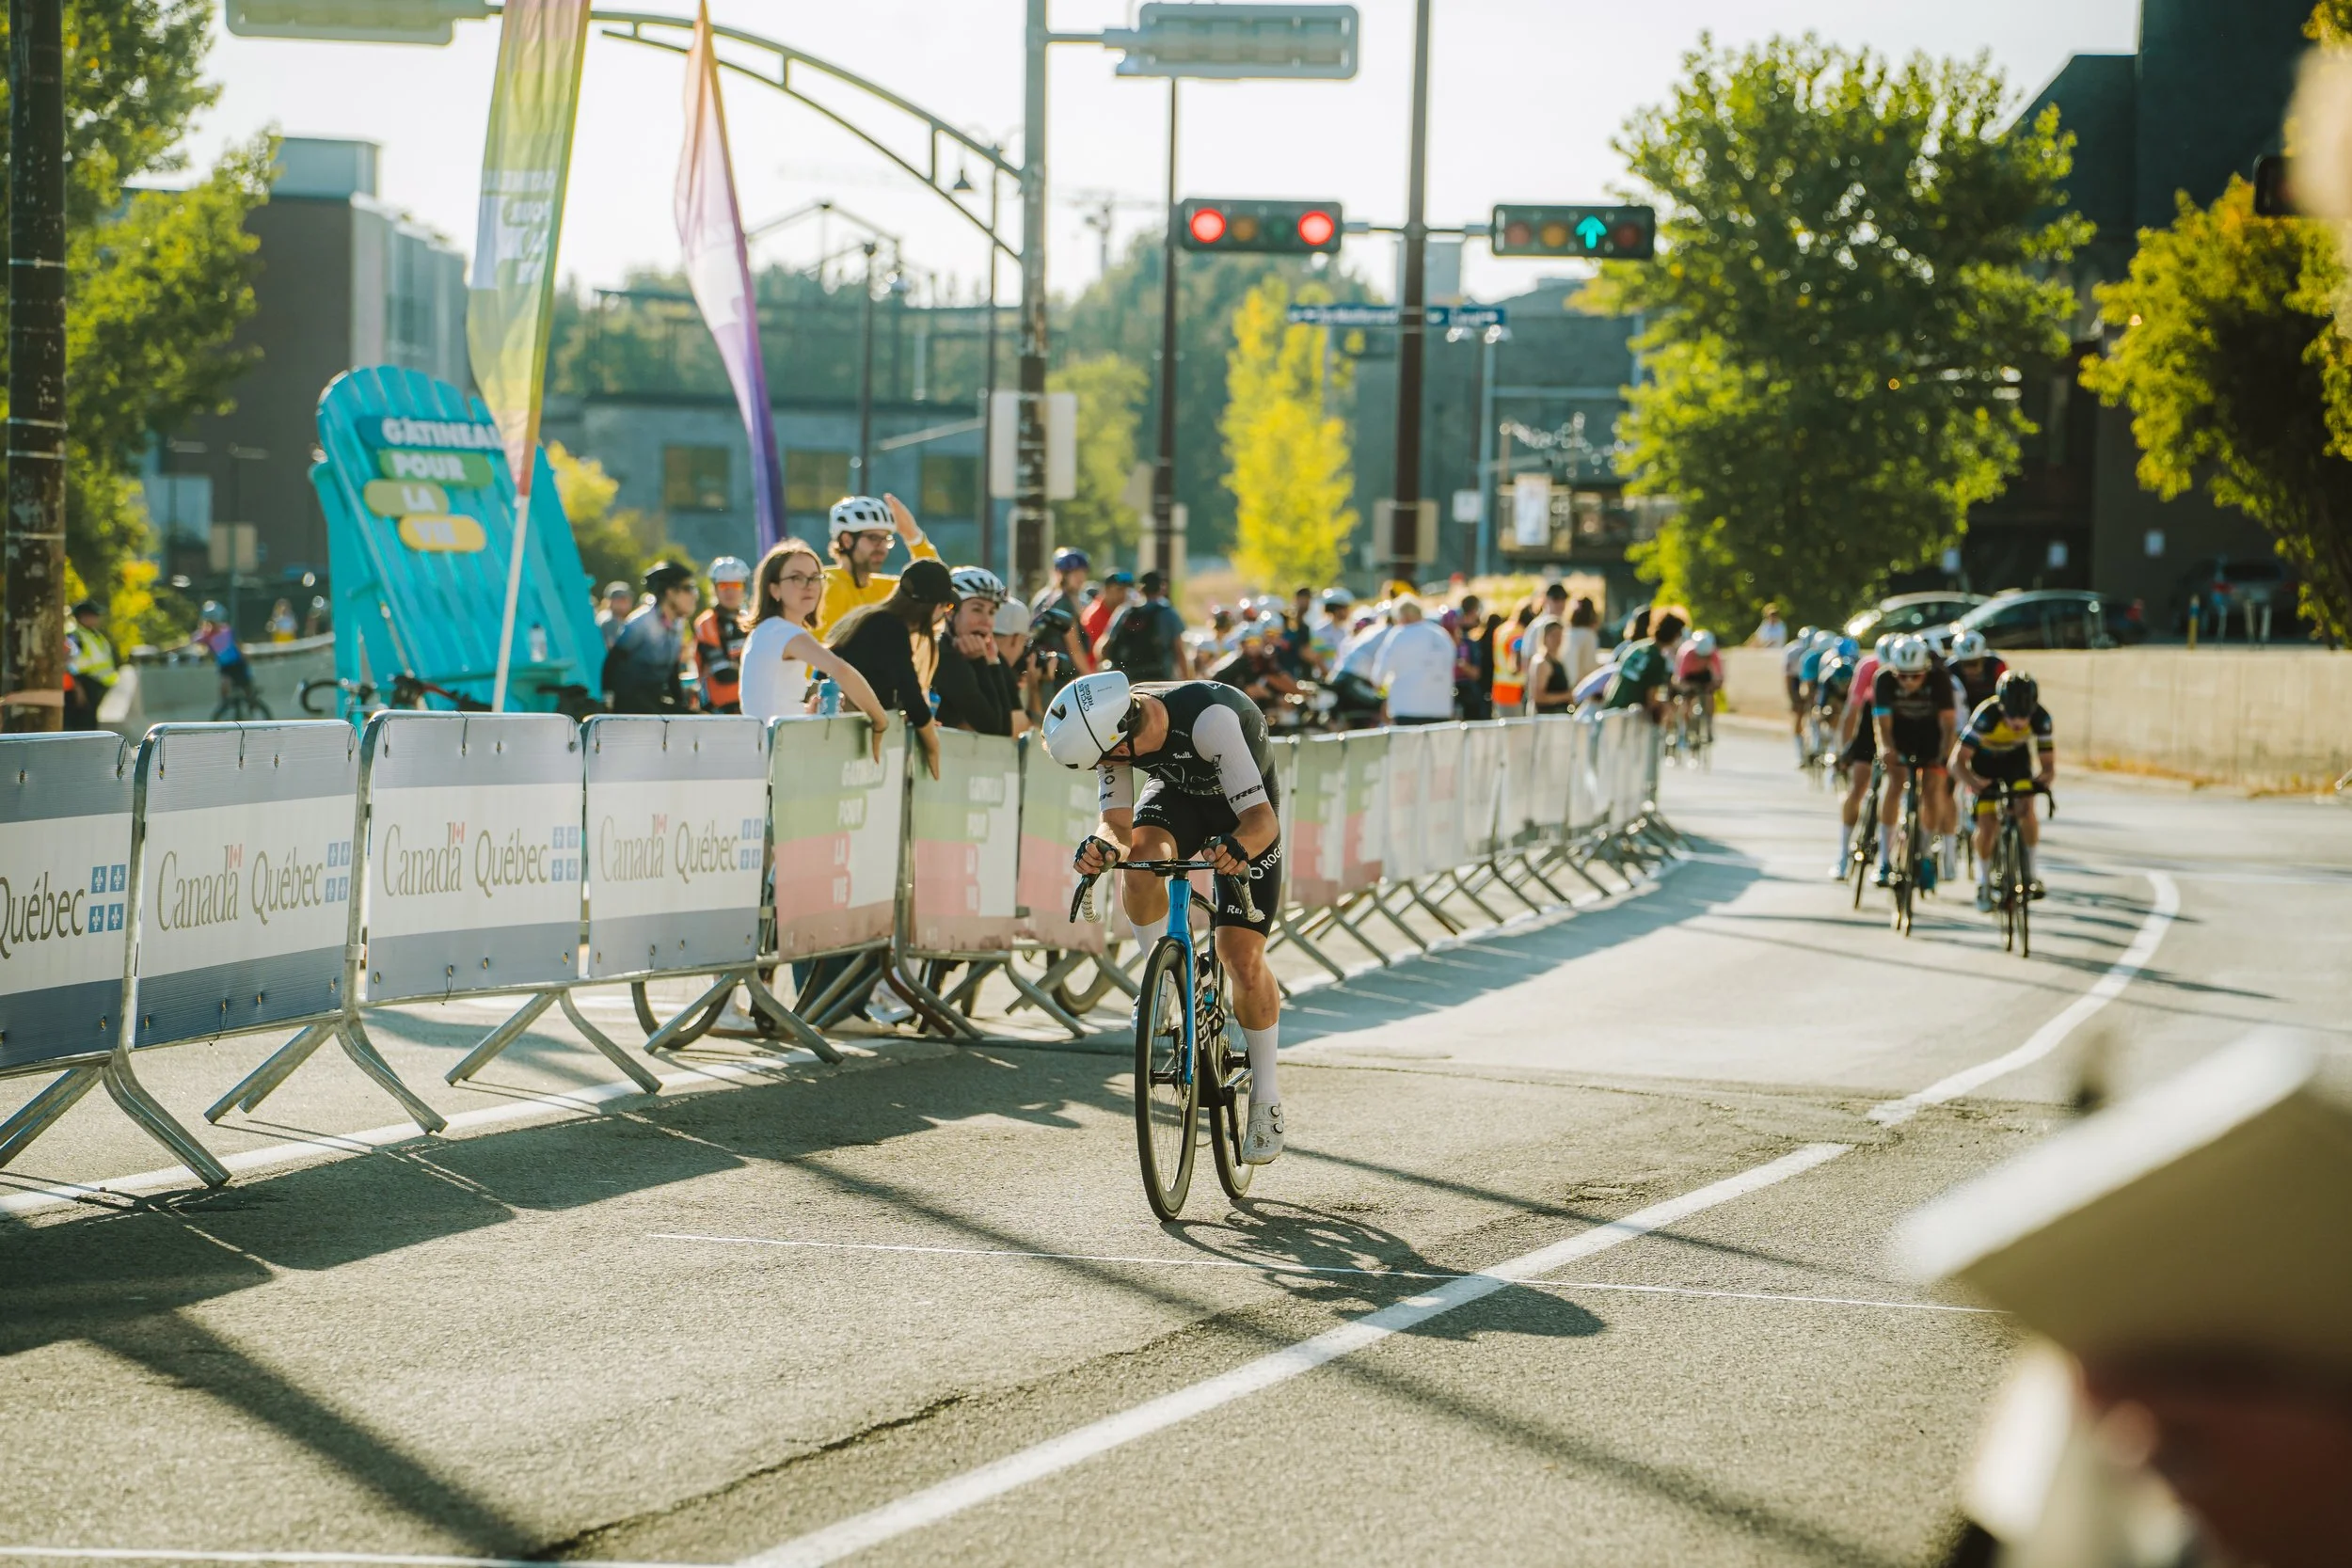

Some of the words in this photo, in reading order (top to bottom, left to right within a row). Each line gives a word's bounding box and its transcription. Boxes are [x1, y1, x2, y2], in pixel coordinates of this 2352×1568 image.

[391, 451, 467, 481] POUR
[401, 485, 437, 512] LA
[1228, 784, 1263, 804] TREK
[383, 821, 462, 897] Canada
[475, 828, 548, 898] Québec
[599, 814, 664, 882] Canada
[675, 820, 739, 884] Québec
[0, 871, 85, 959] Québec
[157, 844, 239, 932] Canada
[251, 847, 323, 926] Québec
